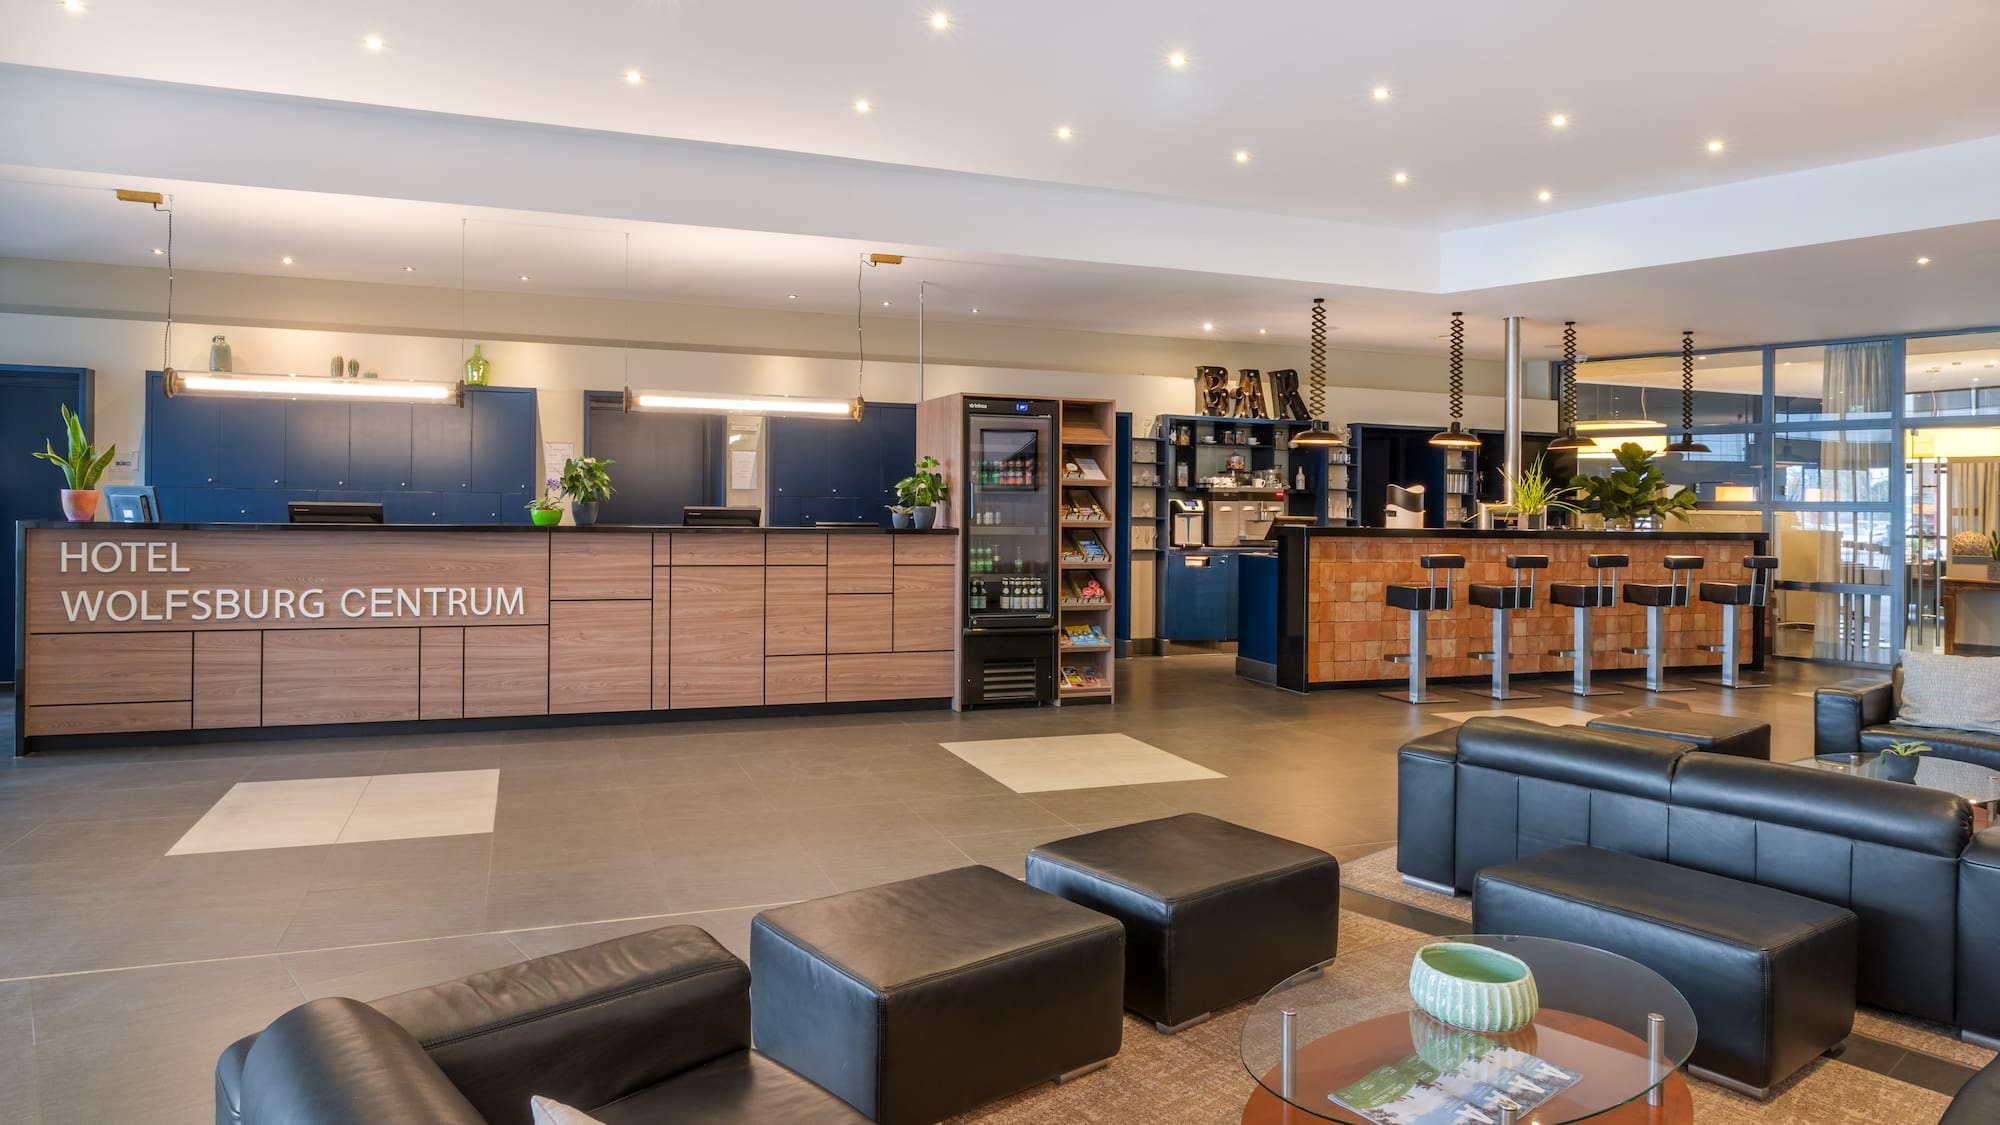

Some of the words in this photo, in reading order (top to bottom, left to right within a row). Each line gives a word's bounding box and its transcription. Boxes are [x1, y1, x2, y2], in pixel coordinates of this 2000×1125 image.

[1194, 365, 1313, 420] BAR
[60, 541, 191, 573] HOTEL
[61, 588, 324, 622] WOLFSBURG
[341, 586, 526, 618] CENTRUM
